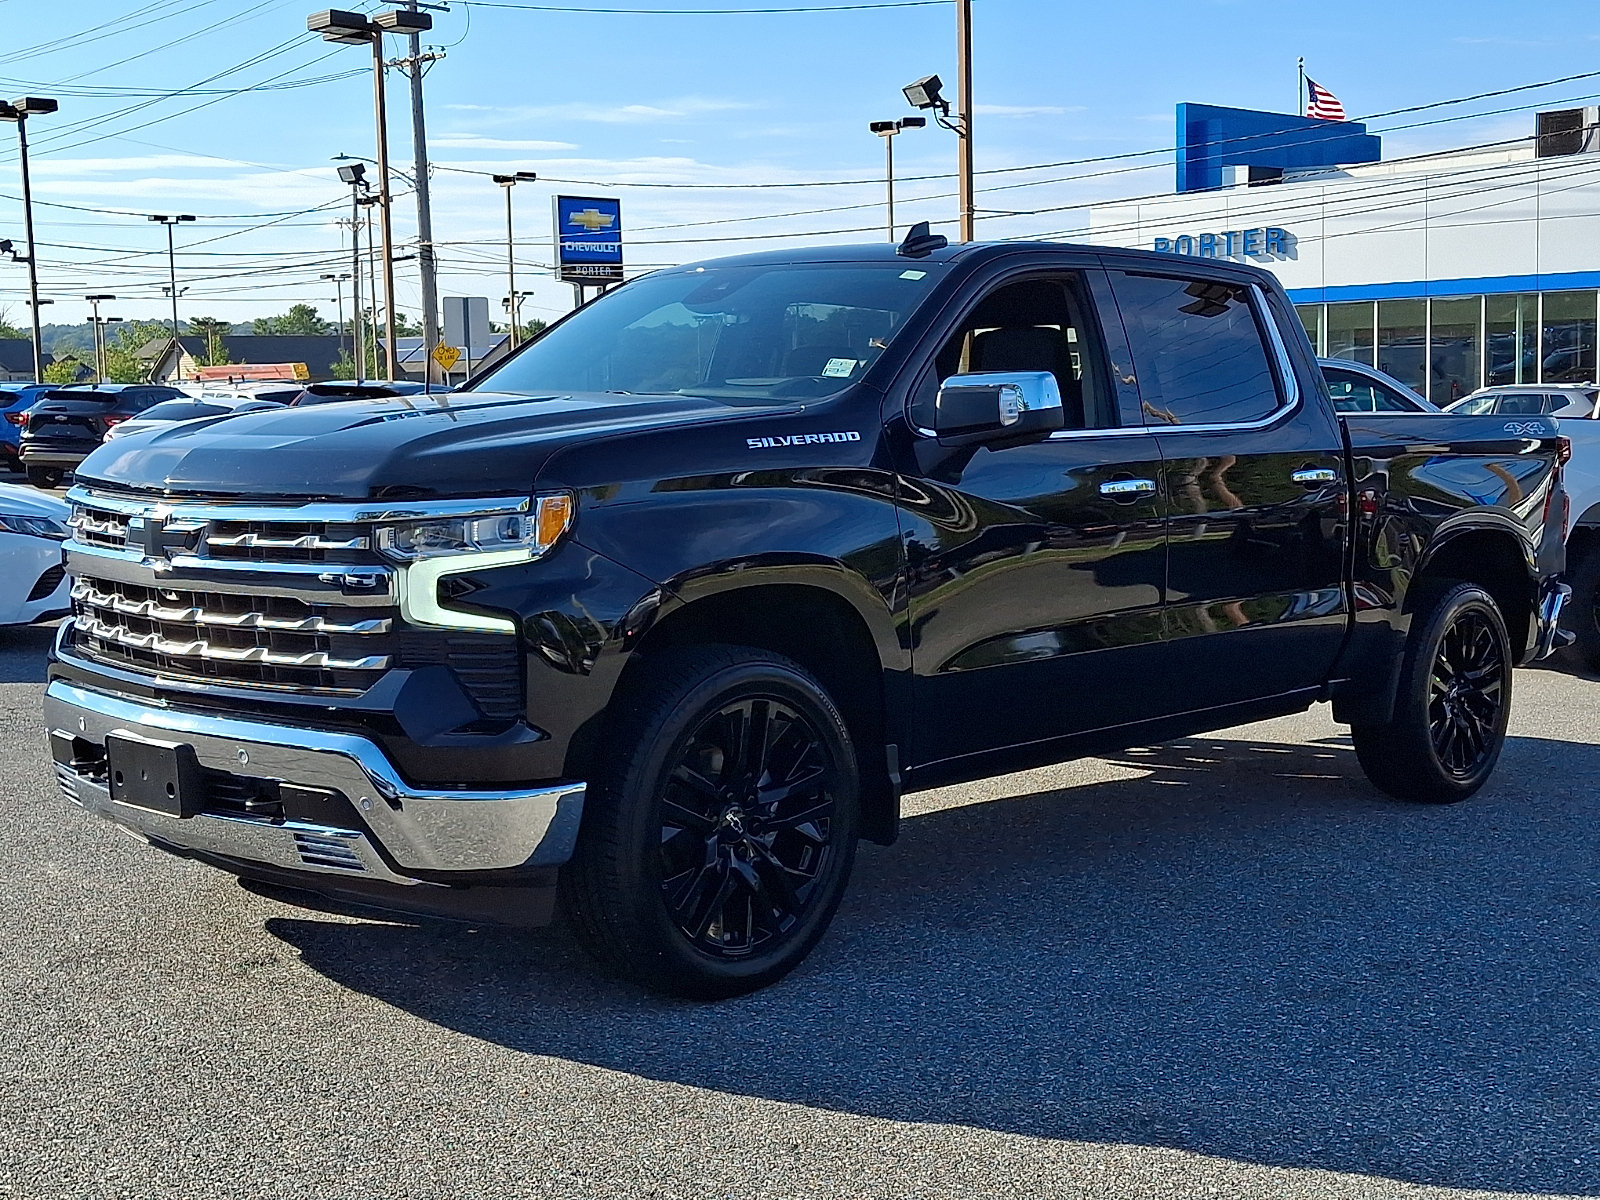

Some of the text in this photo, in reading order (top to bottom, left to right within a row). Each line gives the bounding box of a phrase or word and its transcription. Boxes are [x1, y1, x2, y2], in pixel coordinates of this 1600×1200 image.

[565, 241, 619, 252] CHEVROLET
[1154, 227, 1287, 258] PORTER
[746, 431, 861, 449] SILVERADO
